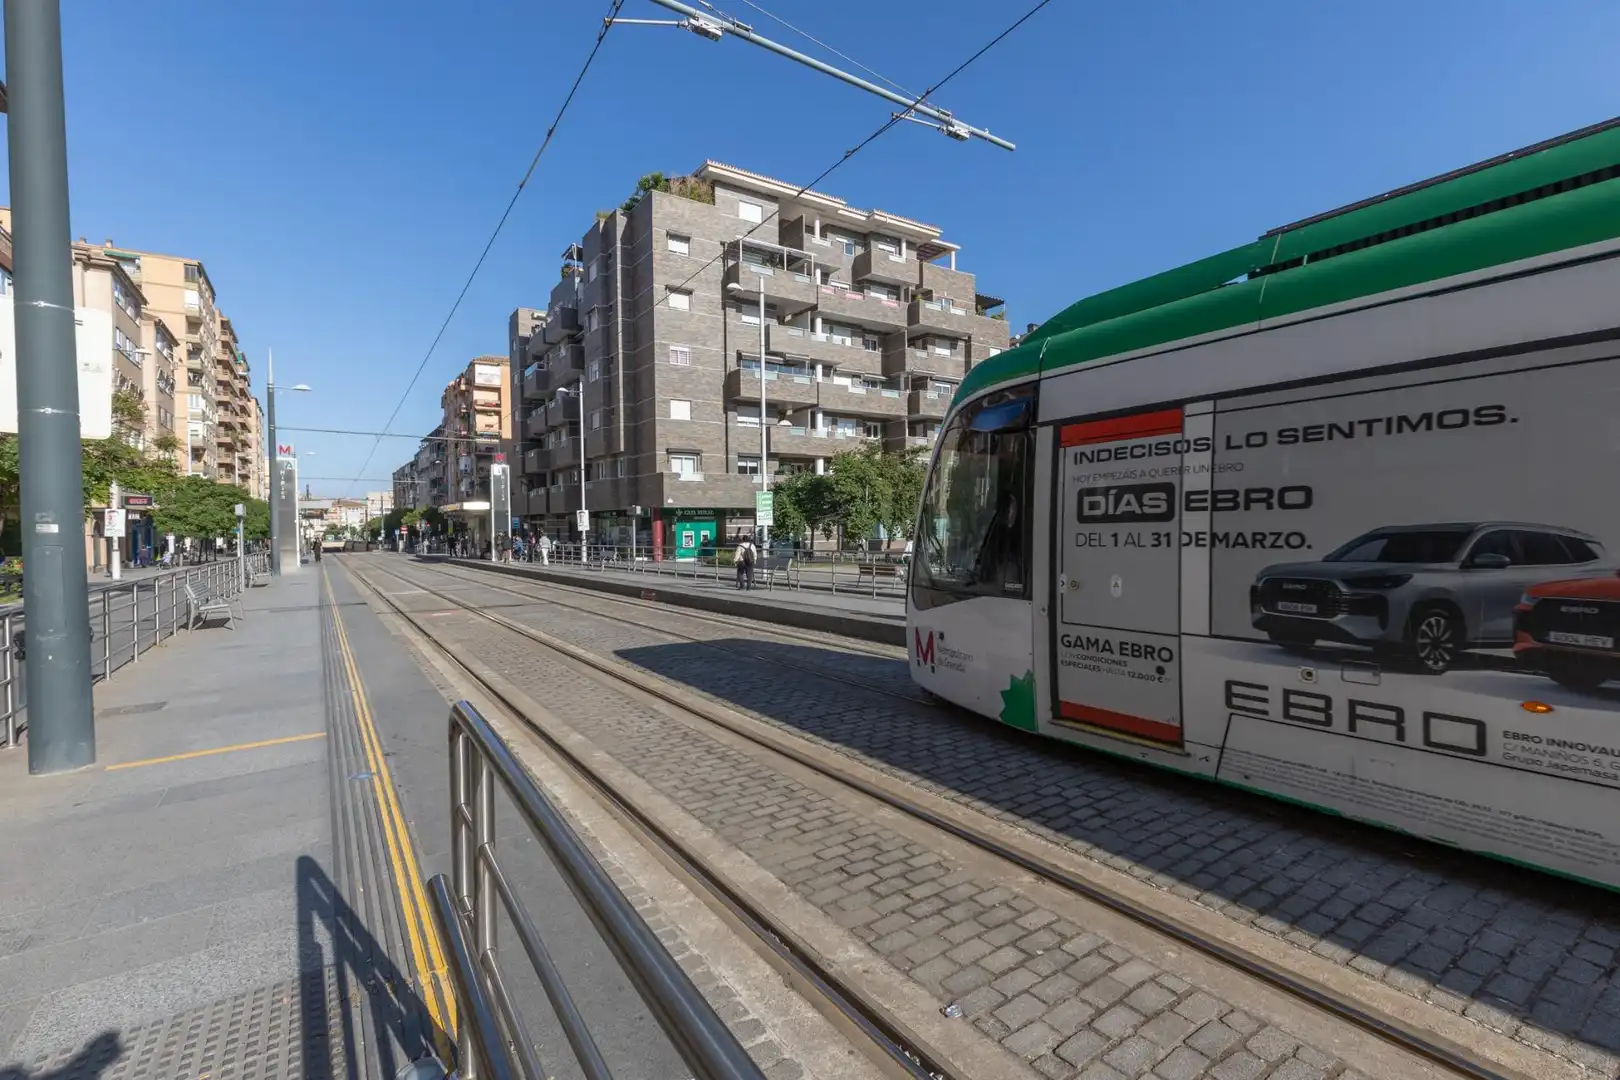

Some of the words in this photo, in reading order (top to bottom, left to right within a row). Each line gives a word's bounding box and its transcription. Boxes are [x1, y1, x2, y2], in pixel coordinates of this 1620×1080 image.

[1074, 437, 1211, 465] INDECISOS
[1225, 431, 1267, 450] LO
[1277, 404, 1519, 446] SENTIMOS.
[1072, 473, 1091, 485] HOY
[1138, 469, 1147, 478] A
[1148, 464, 1191, 479] QUERER
[1193, 463, 1209, 475] UN
[1211, 461, 1244, 474] EBRO
[1082, 489, 1169, 516] DÍAS
[1184, 485, 1313, 512] EBRO
[1075, 532, 1105, 548] DEL
[1110, 532, 1119, 547] 1
[1123, 532, 1146, 548] AL
[1151, 532, 1171, 548] 31
[1210, 531, 1313, 549] MARZO.
[914, 627, 936, 667] M
[1060, 633, 1114, 658] GAMA
[1119, 640, 1174, 662] EBRO
[1060, 659, 1101, 673] ESPECIALES
[1076, 653, 1128, 668] CONDICIONES
[1225, 680, 1486, 756] EBRO
[1502, 730, 1543, 744] EBRO
[1502, 752, 1543, 767] Grupo
